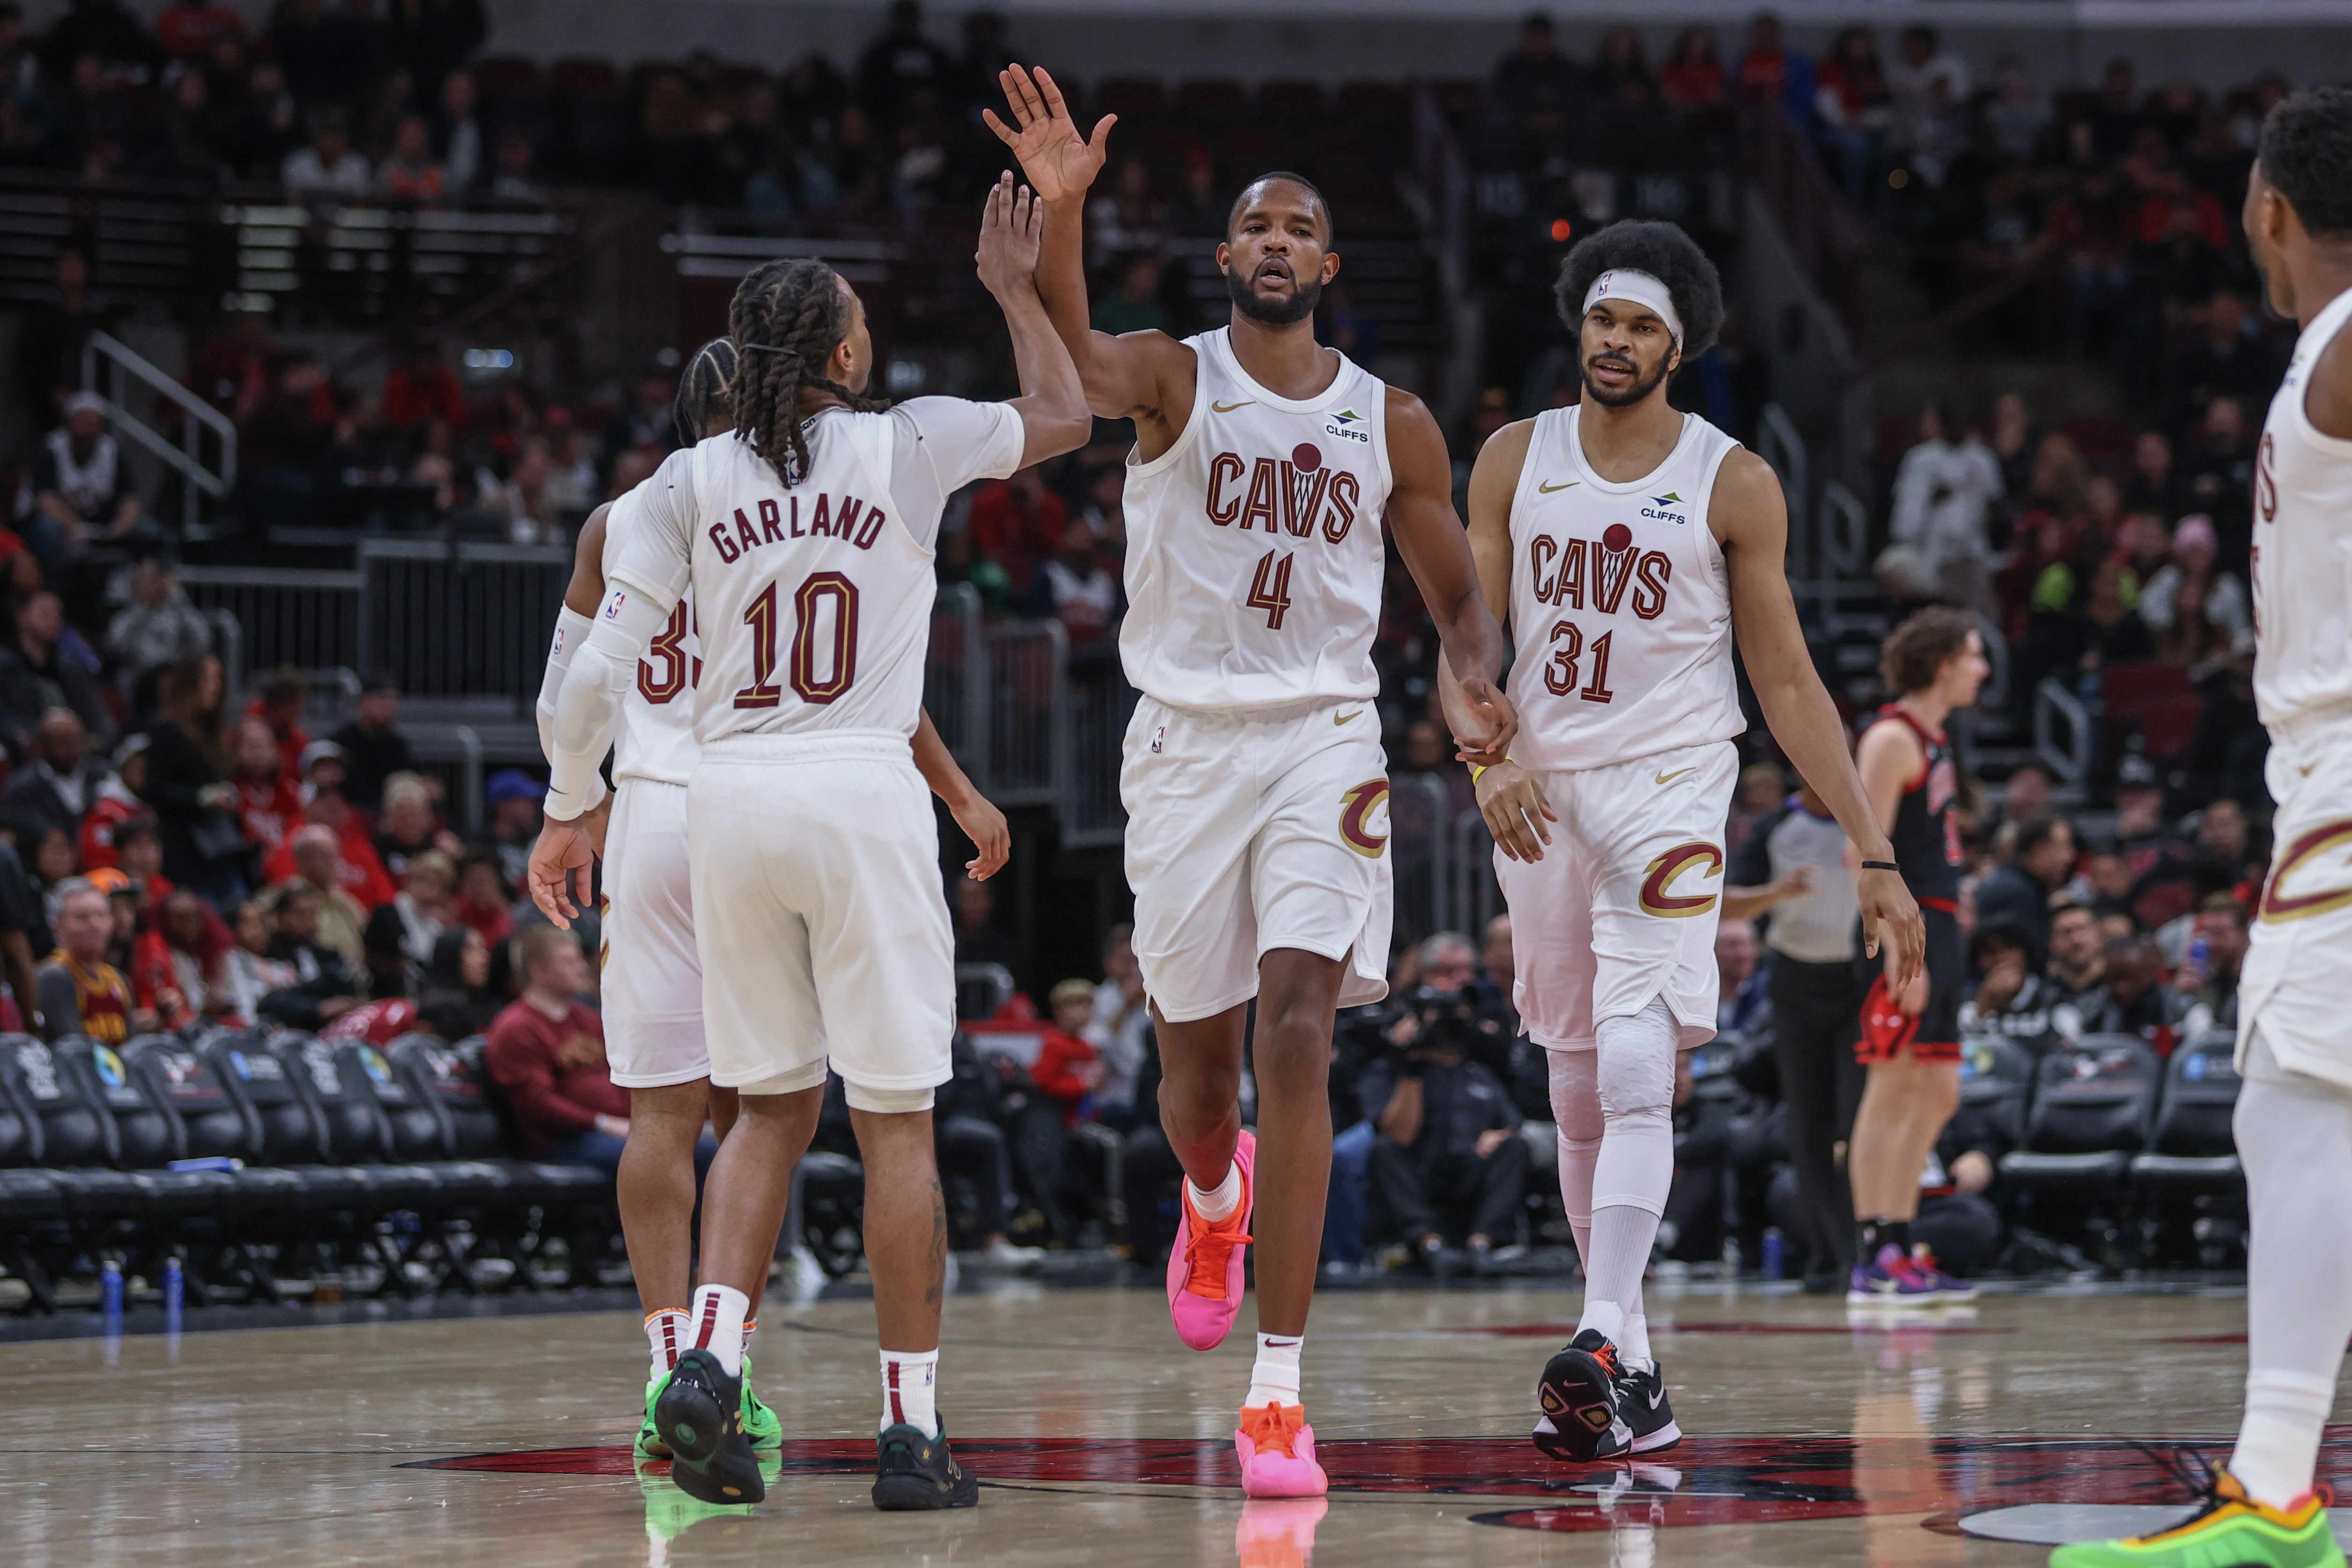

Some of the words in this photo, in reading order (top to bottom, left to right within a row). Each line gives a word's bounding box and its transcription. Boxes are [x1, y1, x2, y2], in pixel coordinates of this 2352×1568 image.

[1326, 424, 1368, 443] CLIFFS
[709, 492, 885, 564] GARLAND
[1205, 451, 1360, 545] CAVS
[1641, 508, 1686, 525] CLIFFS
[1246, 549, 1293, 630] 4
[1531, 533, 1672, 620] CAVS
[637, 598, 703, 704] 3
[733, 571, 859, 709] 10
[1543, 620, 1613, 704] 31
[1639, 841, 1724, 918] C
